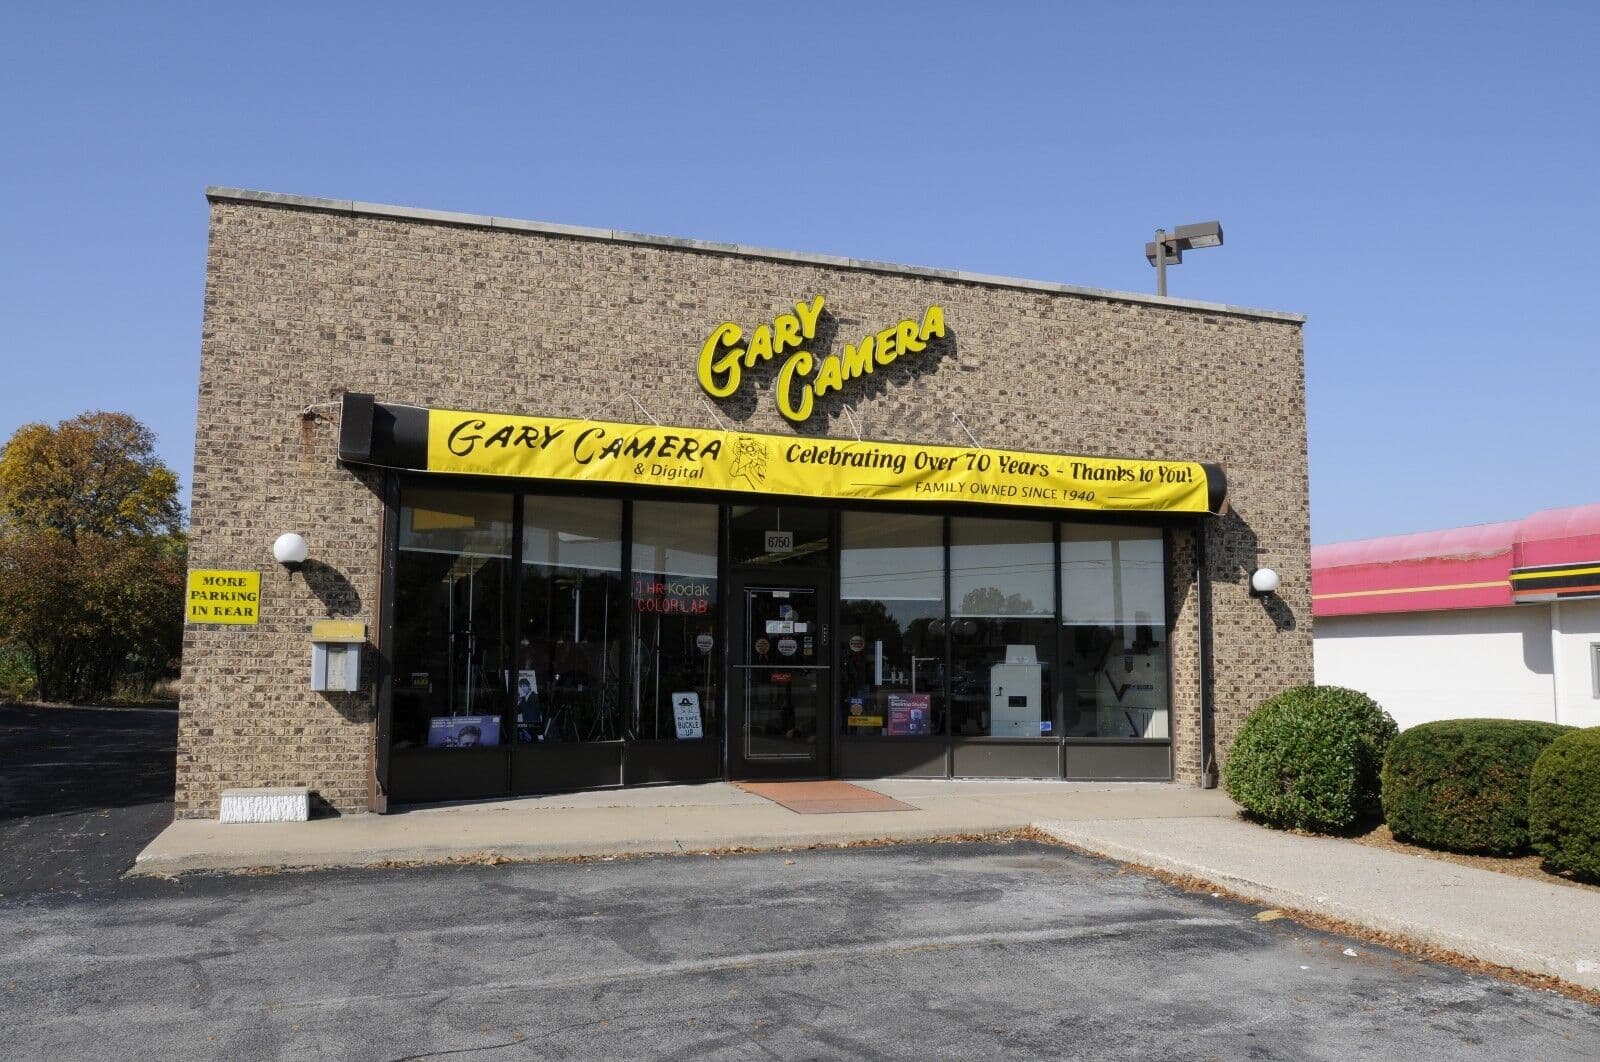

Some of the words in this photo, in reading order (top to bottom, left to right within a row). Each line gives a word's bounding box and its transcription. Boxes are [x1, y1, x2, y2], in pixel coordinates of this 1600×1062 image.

[697, 295, 825, 398] GARY
[776, 304, 945, 422] CAMERA
[448, 420, 565, 457] GARY
[574, 427, 722, 465] CAMERA
[633, 463, 645, 476] &
[651, 463, 704, 481] Digital
[786, 443, 906, 474] Celebrating
[915, 451, 957, 471] Over
[966, 453, 991, 472] 70
[999, 455, 1049, 477] Years
[1071, 462, 1135, 482] Thanks
[1140, 466, 1153, 482] to
[1158, 465, 1193, 483] You!
[915, 481, 965, 493] FAMILY
[970, 482, 1017, 497] OWNED
[1021, 486, 1057, 499] SINCE
[1062, 489, 1095, 502] 1940
[202, 576, 247, 587] MORE
[647, 582, 665, 594] HR
[668, 582, 709, 597] Kodak
[191, 590, 257, 602] PARKING
[192, 605, 208, 616] IN
[214, 606, 253, 617] REAR
[677, 721, 699, 729] BUCKLE
